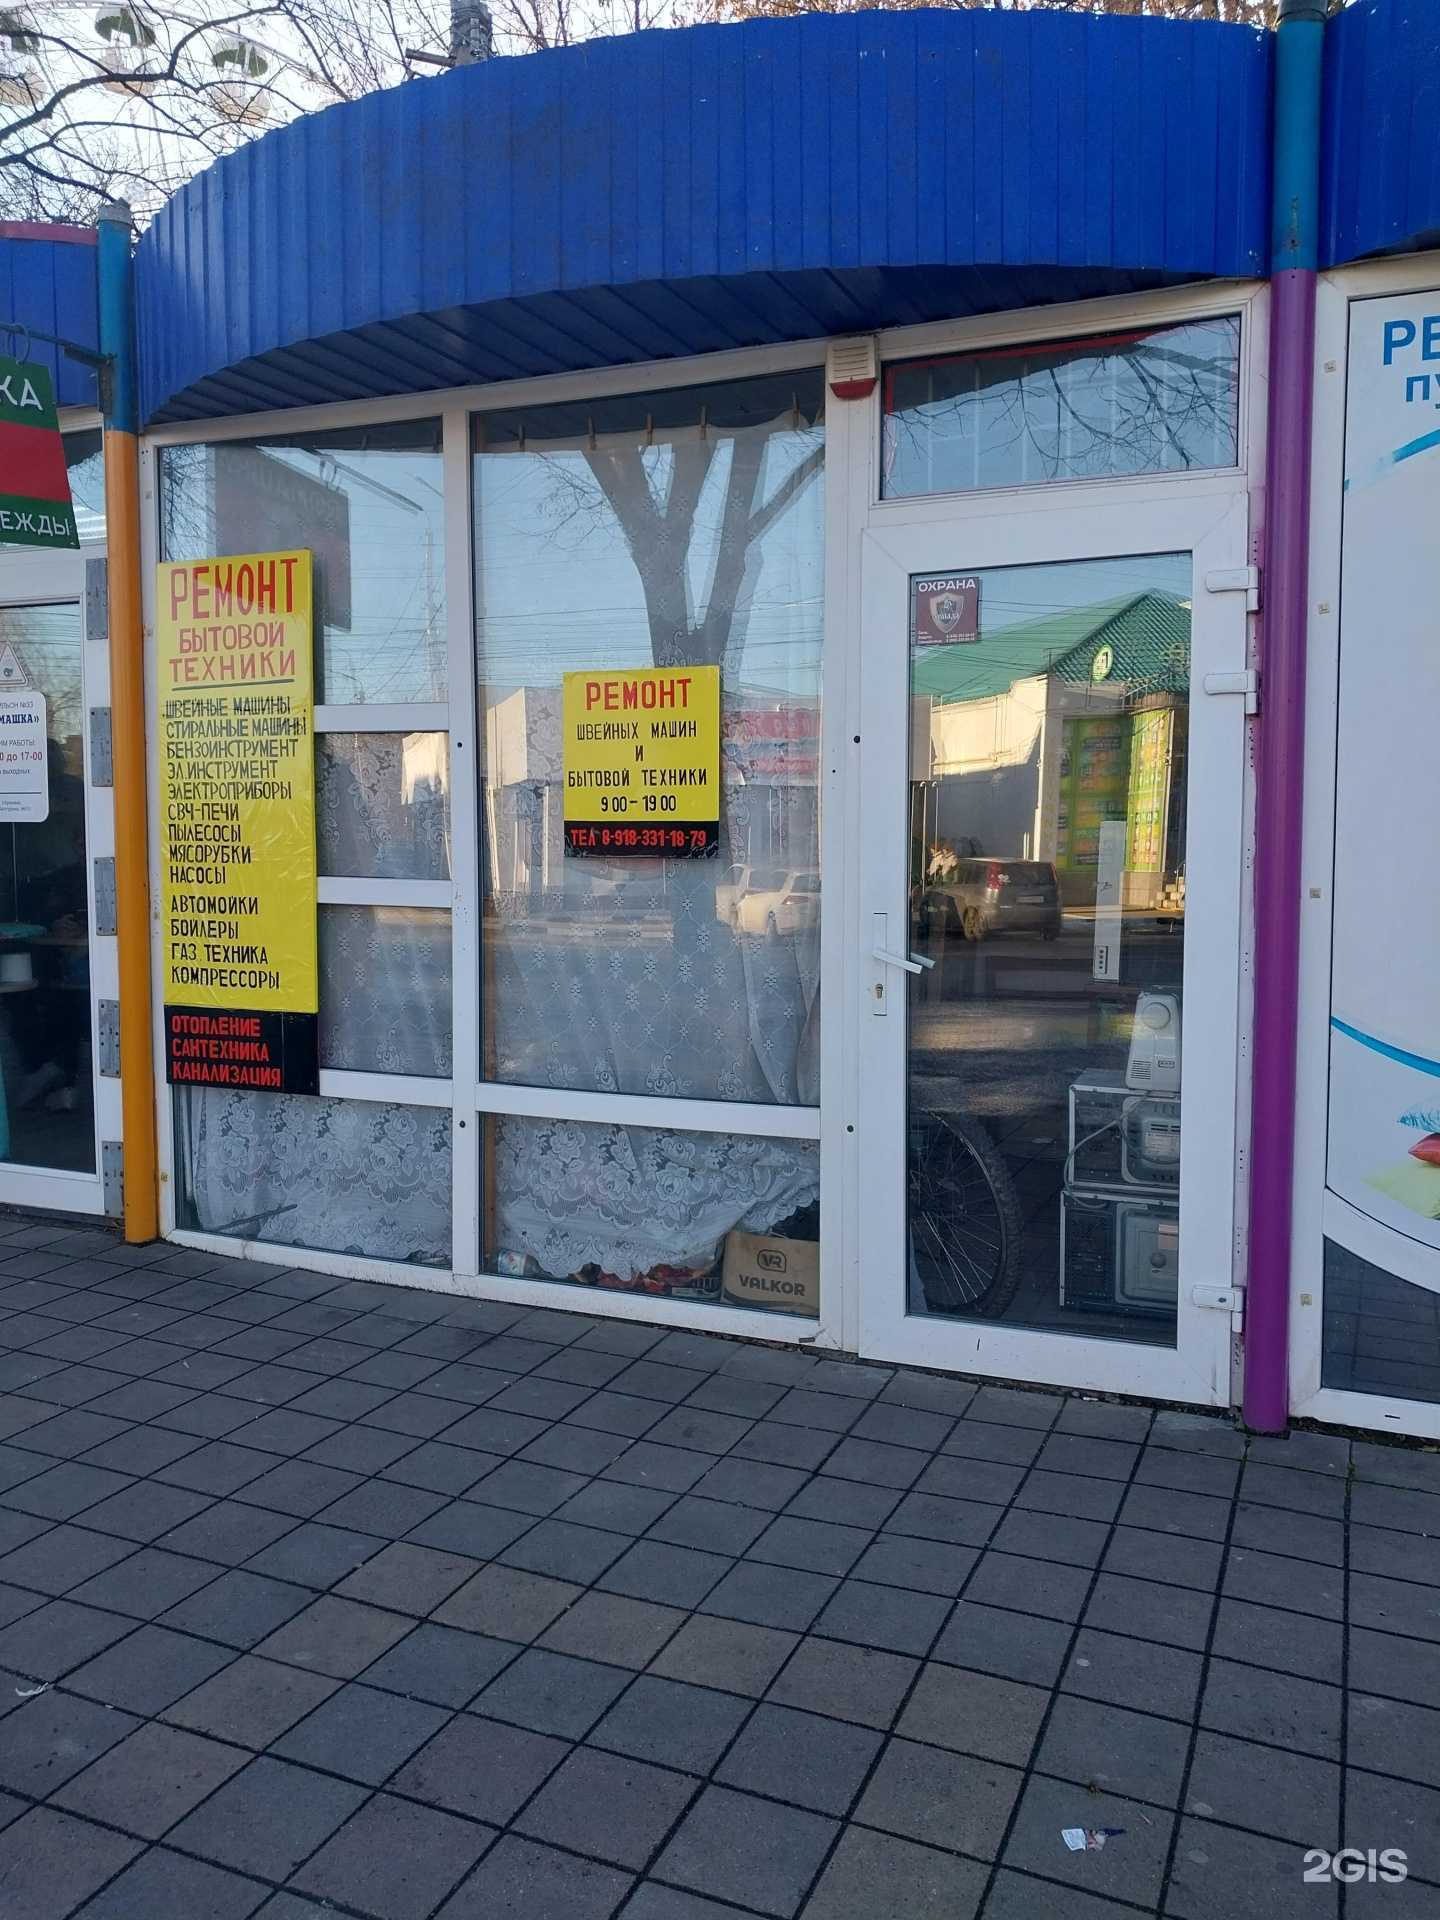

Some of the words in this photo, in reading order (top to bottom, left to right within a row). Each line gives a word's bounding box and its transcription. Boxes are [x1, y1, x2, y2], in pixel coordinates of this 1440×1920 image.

[1383, 315, 1440, 365] РЕ
[0, 511, 70, 536] ЕЖДЫ
[170, 558, 298, 621] РЕМОНТ
[918, 579, 976, 592] ОХРАНА
[179, 622, 284, 654] БЫТОВОЙ
[169, 650, 295, 682] ТЕХНИКИ
[585, 678, 692, 711] РЕМОНТ
[165, 697, 228, 719] ШВЕЙНЫЕ
[233, 695, 291, 716] МАШИНЫ
[166, 719, 249, 739] СТИРАЛЬНЫЕ
[252, 716, 307, 737] МАШИНЫ
[577, 721, 639, 741] ШВЕЙНЫХ
[651, 720, 697, 739] МАШИН
[7, 753, 18, 762] до
[21, 751, 43, 761] 17-00
[166, 738, 299, 760] БЕНЗОИНСТРУМЕНТ
[635, 745, 644, 761] И
[568, 768, 630, 788] БЫТОВОЙ
[641, 768, 708, 786] ТЕХНИКИ
[167, 781, 292, 801] ЭЛЕКТРОПРИБОРЫ
[168, 802, 240, 821] СВЧ-ПЕЧИ
[168, 823, 241, 843] ПЫЛЕСОСЫ
[602, 828, 707, 847] 8-918-331-18-79
[169, 845, 252, 864] МЯСОРУБКИ
[170, 866, 226, 884] НАСОСЫ
[171, 895, 258, 915] АВТОМОЙКИ
[170, 919, 239, 939] БОЙЛЕРЫ
[204, 944, 268, 964] ТЕХНИКА
[171, 966, 280, 989] КОМПРЕССОРЫ
[171, 1014, 261, 1037] ОТОПЛЕНИЕ
[171, 1039, 270, 1062] САНТЕХНИКА
[172, 1061, 282, 1088] КАНАЛИЗАЦИЯ
[738, 1274, 806, 1297] VALKOR
